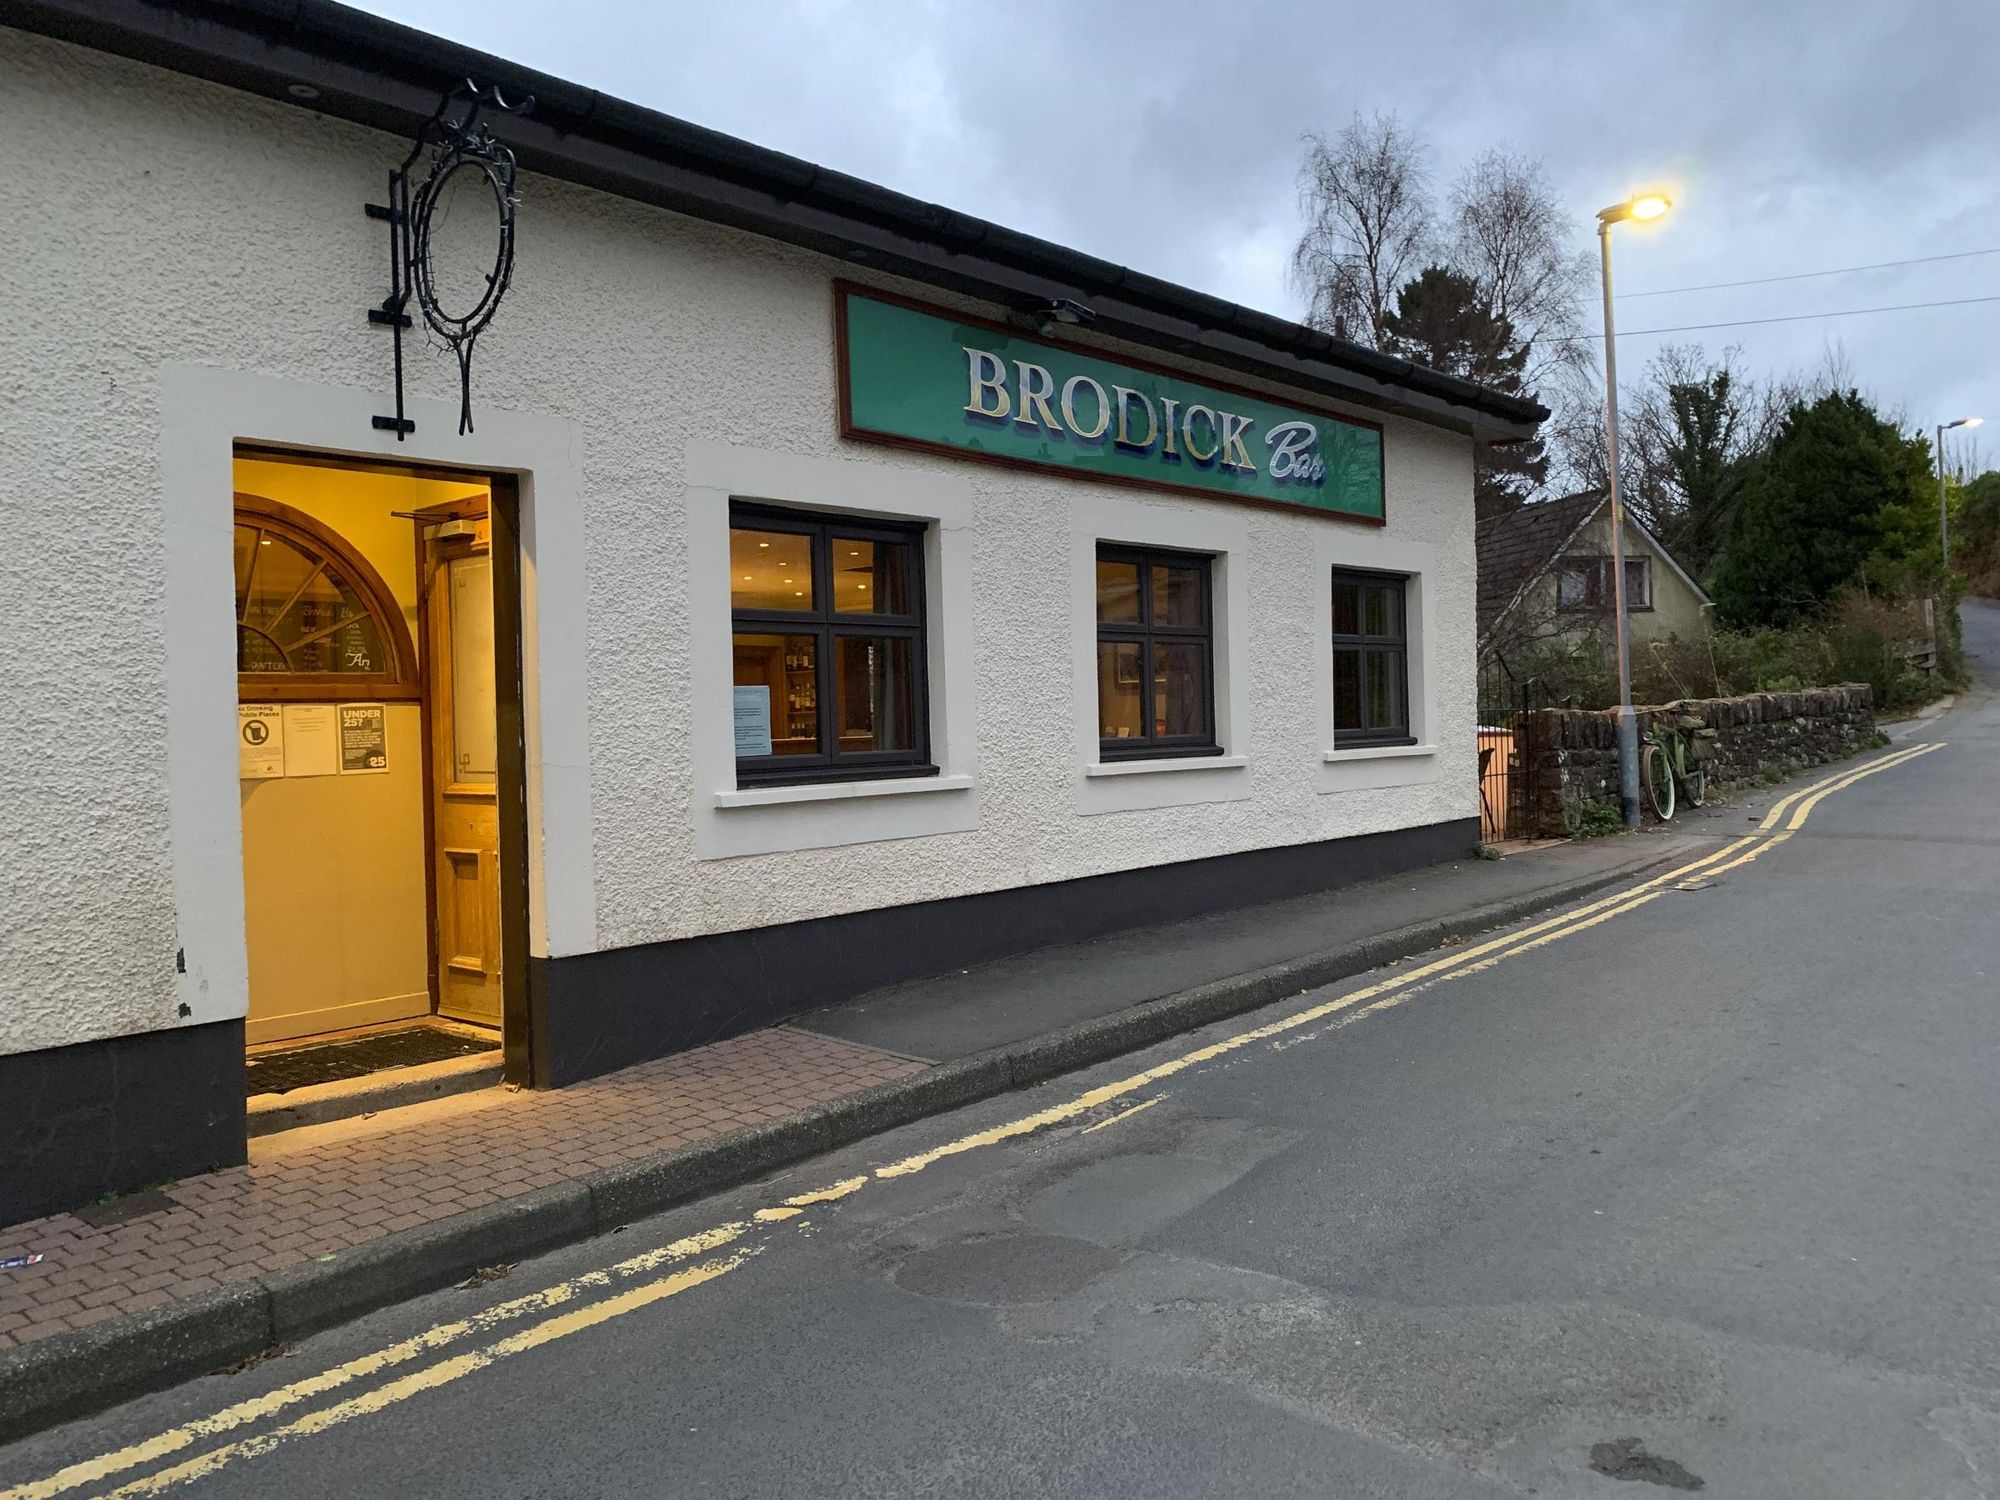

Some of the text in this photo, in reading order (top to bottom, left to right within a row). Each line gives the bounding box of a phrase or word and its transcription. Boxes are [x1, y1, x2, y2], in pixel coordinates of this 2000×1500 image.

[962, 347, 1325, 484] BRODICK Bar
[343, 709, 381, 719] UNDER
[343, 718, 364, 727] 25?
[370, 756, 386, 767] 25
